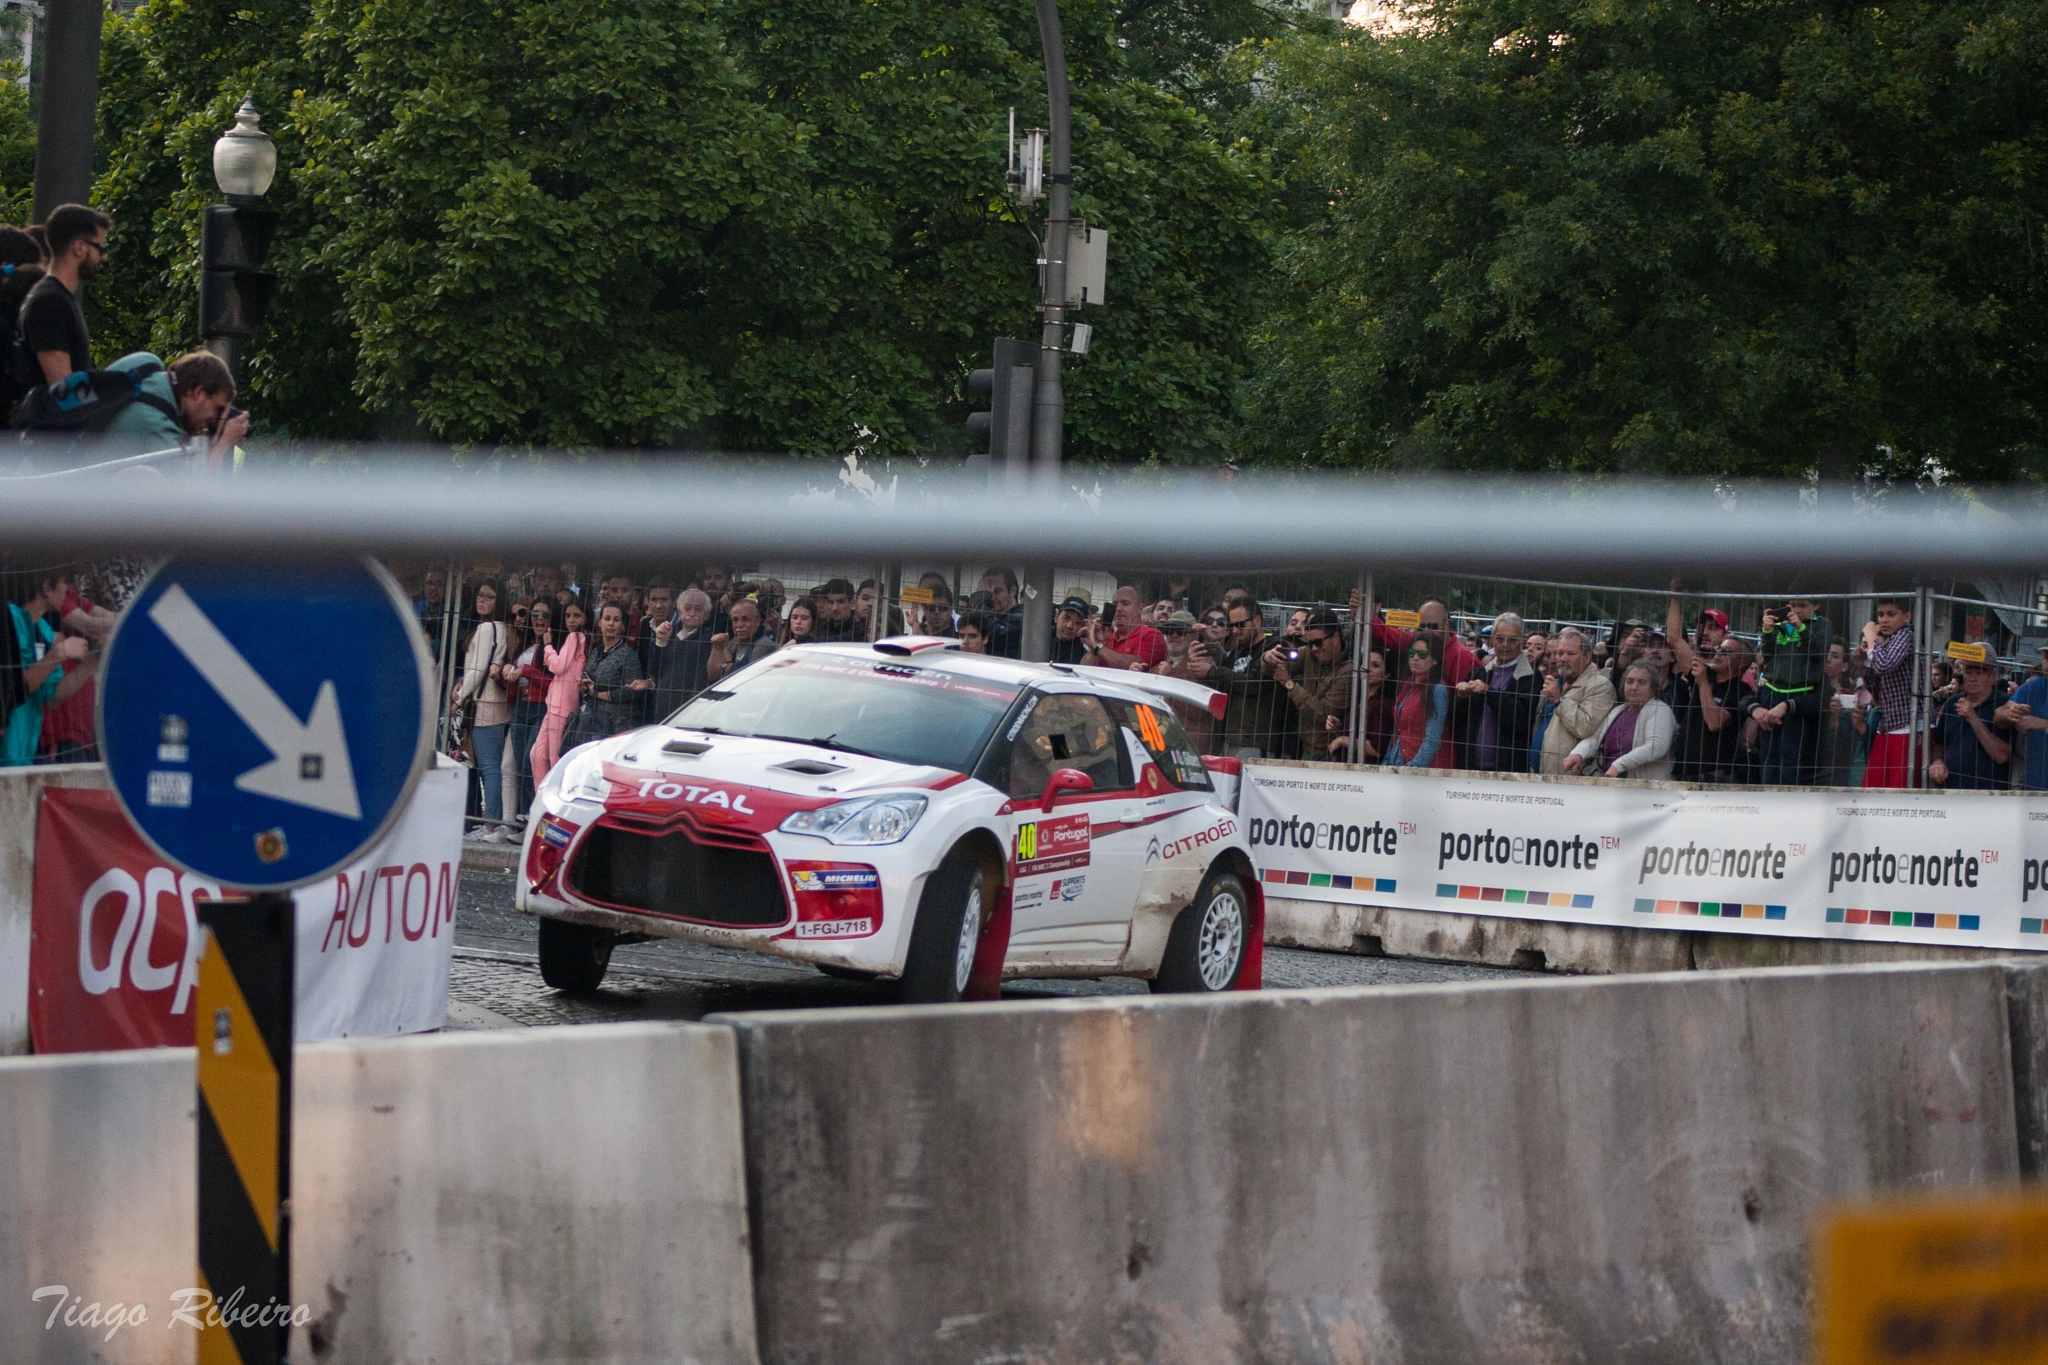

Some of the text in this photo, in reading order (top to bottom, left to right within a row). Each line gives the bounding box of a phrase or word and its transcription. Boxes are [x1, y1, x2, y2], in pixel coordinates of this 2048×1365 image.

[858, 667, 939, 687] Championship
[1135, 704, 1166, 752] 40
[637, 777, 756, 815] TOTAL
[1253, 778, 1277, 787] TURISMO
[1278, 780, 1285, 788] DO
[1286, 781, 1303, 789] PORTO
[1309, 782, 1327, 791] NORTE
[1328, 783, 1335, 792] DE
[1336, 784, 1364, 793] PORTUGAL
[1445, 791, 1564, 806] TURISMO DO PORTO E NORTE DE PORTUGAL
[1836, 807, 1946, 819] TURISMO DO PORTO E NORTE DE PORTUGAL
[1018, 823, 1035, 860] 40
[1053, 826, 1089, 842] Portugal
[1162, 818, 1238, 860] CITROËN
[1250, 814, 1417, 856] portoenorte TEM
[1438, 828, 1620, 870] portoenorte TEM
[1638, 841, 1806, 885] portoenorte TEM
[824, 874, 877, 883] MICHELIN
[1062, 875, 1086, 887] SUPPORTS
[1828, 846, 1999, 894] portoenorte TEM
[800, 920, 867, 935] 1-FGJ-718
